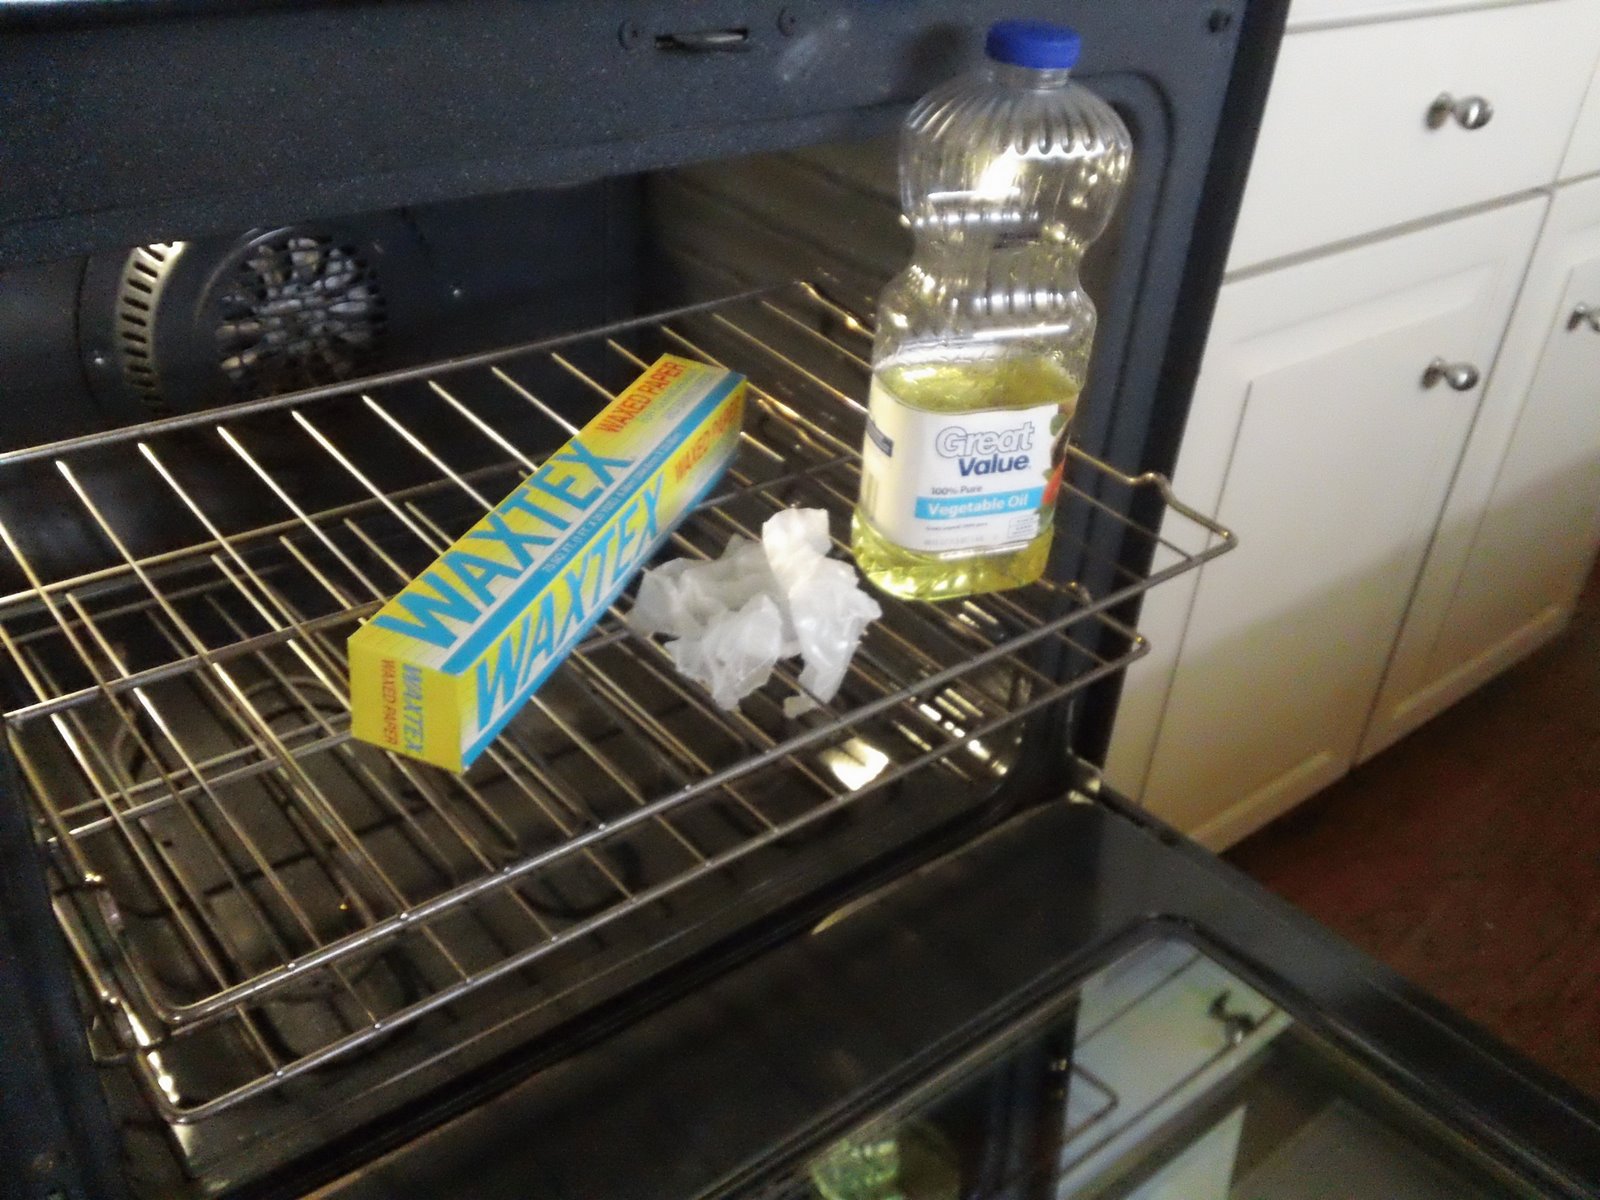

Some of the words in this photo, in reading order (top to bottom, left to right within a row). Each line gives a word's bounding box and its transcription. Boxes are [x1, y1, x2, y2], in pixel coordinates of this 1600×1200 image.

[596, 392, 652, 433] WAXED
[644, 361, 687, 396] PAPER
[935, 421, 1036, 460] Great
[958, 453, 1031, 477] Value
[928, 498, 1005, 518] Vegetable
[1008, 493, 1029, 509] Oil
[931, 486, 958, 497] 100%
[959, 484, 983, 495] Pure
[371, 437, 637, 650] WAXTEX
[474, 470, 666, 733] WAXTEX
[402, 662, 424, 753] WAXTEX
